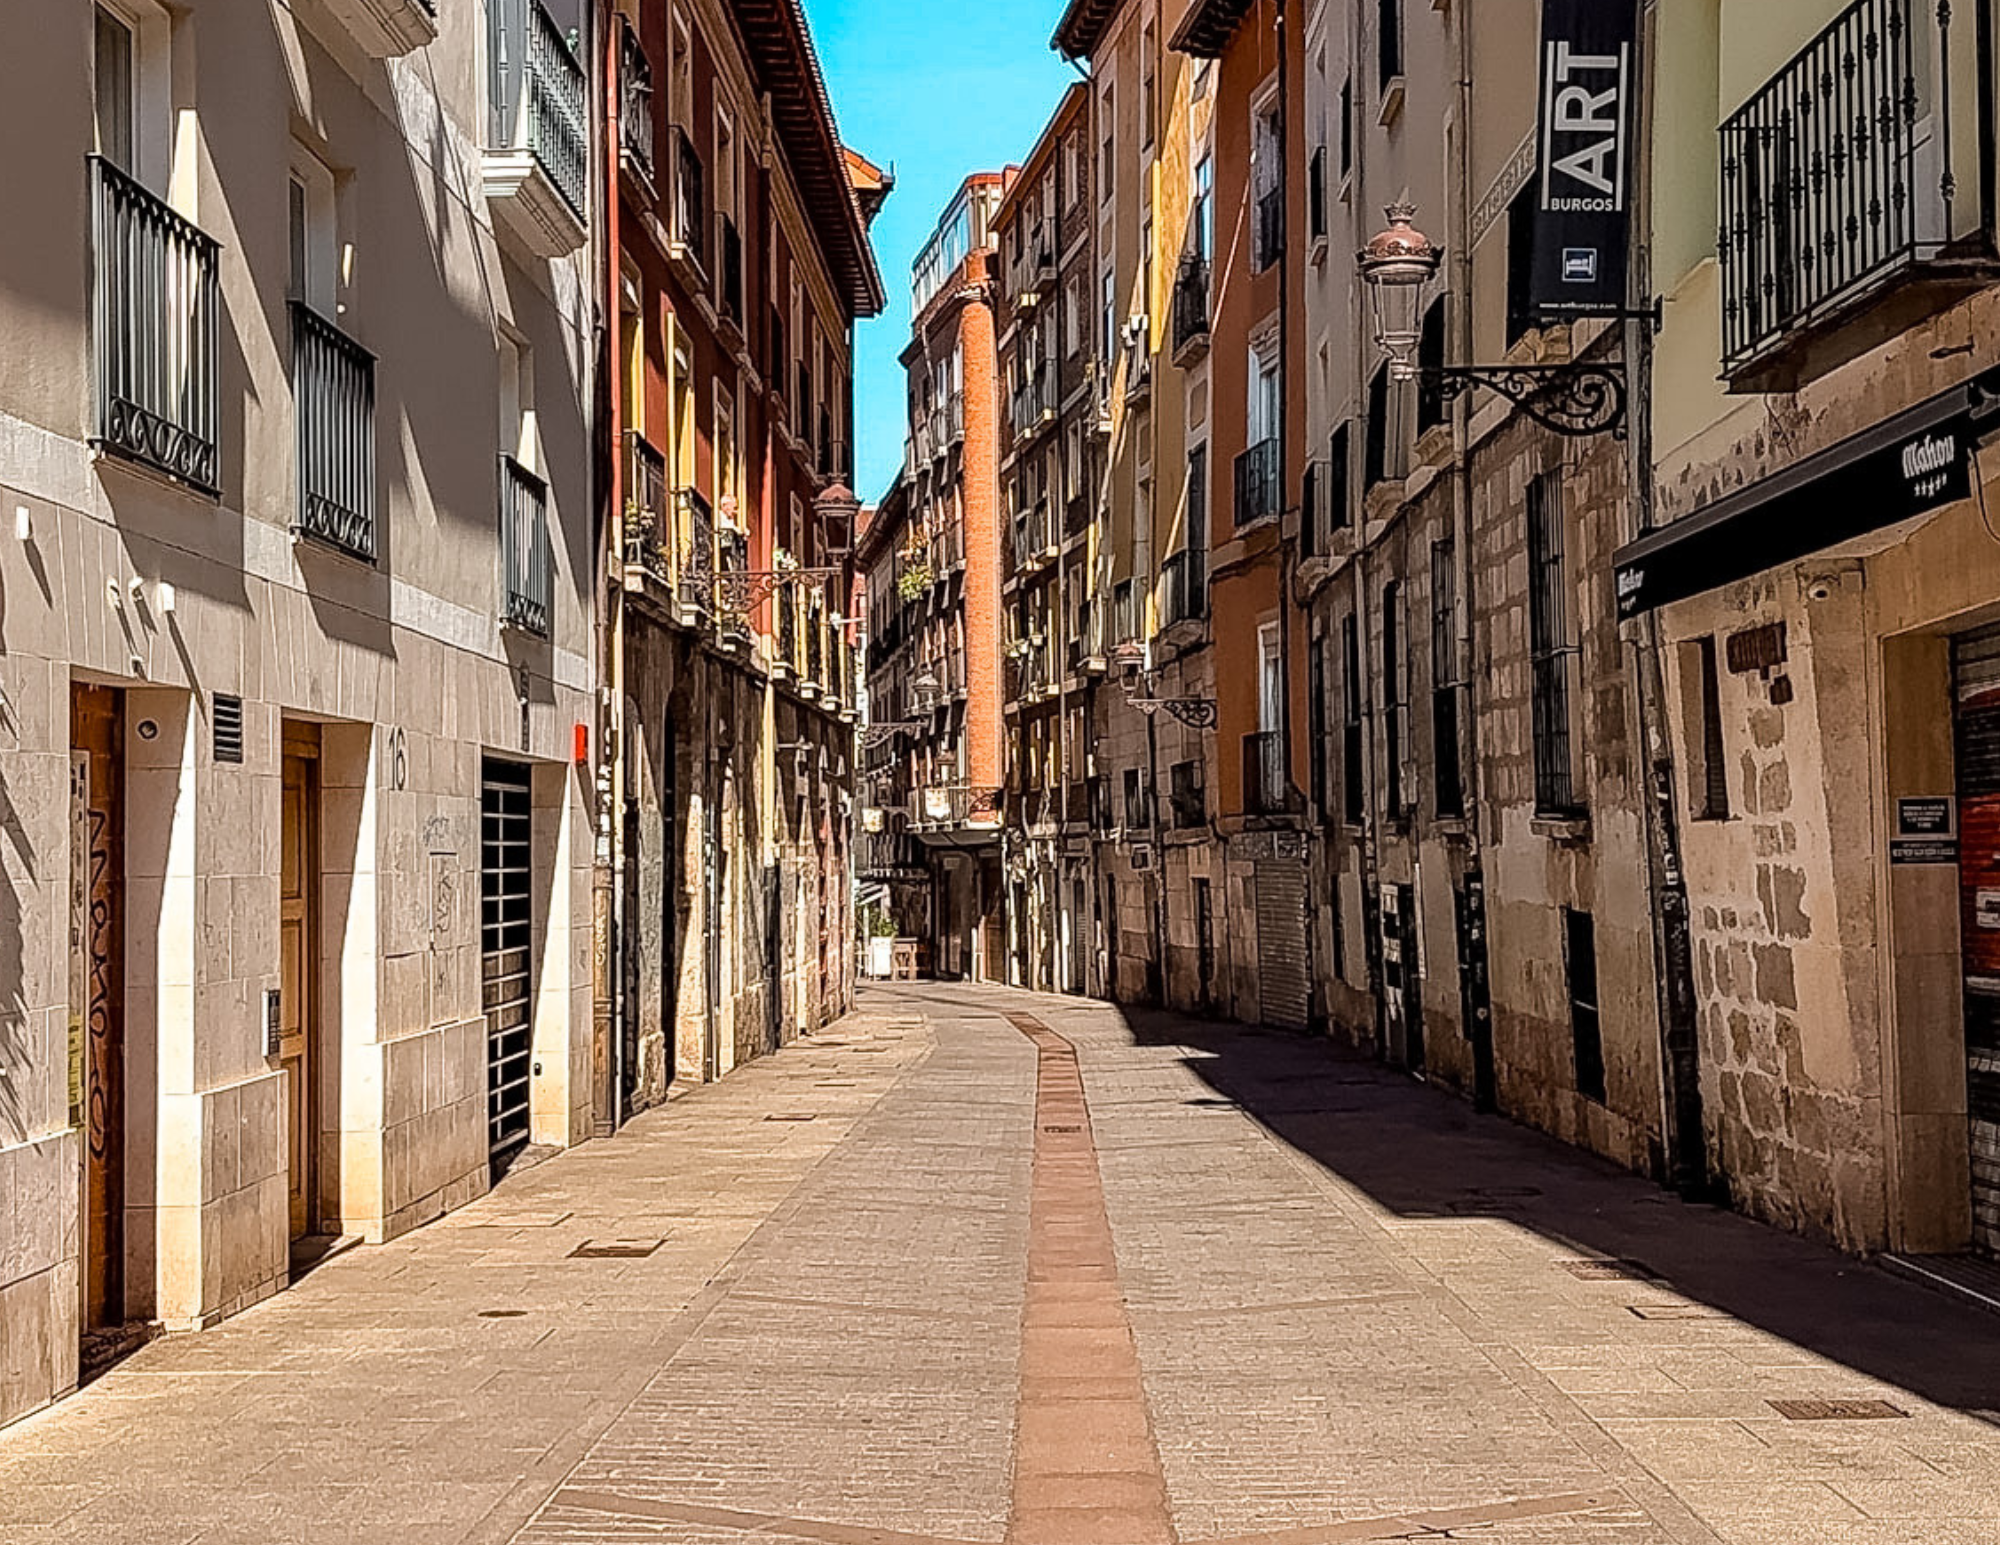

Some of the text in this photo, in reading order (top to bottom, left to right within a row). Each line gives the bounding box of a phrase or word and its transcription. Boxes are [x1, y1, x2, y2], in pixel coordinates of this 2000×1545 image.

[1552, 41, 1618, 194] ART
[1551, 198, 1614, 212] BURGOS
[1902, 434, 1954, 479] Mahou
[388, 726, 406, 791] 16
